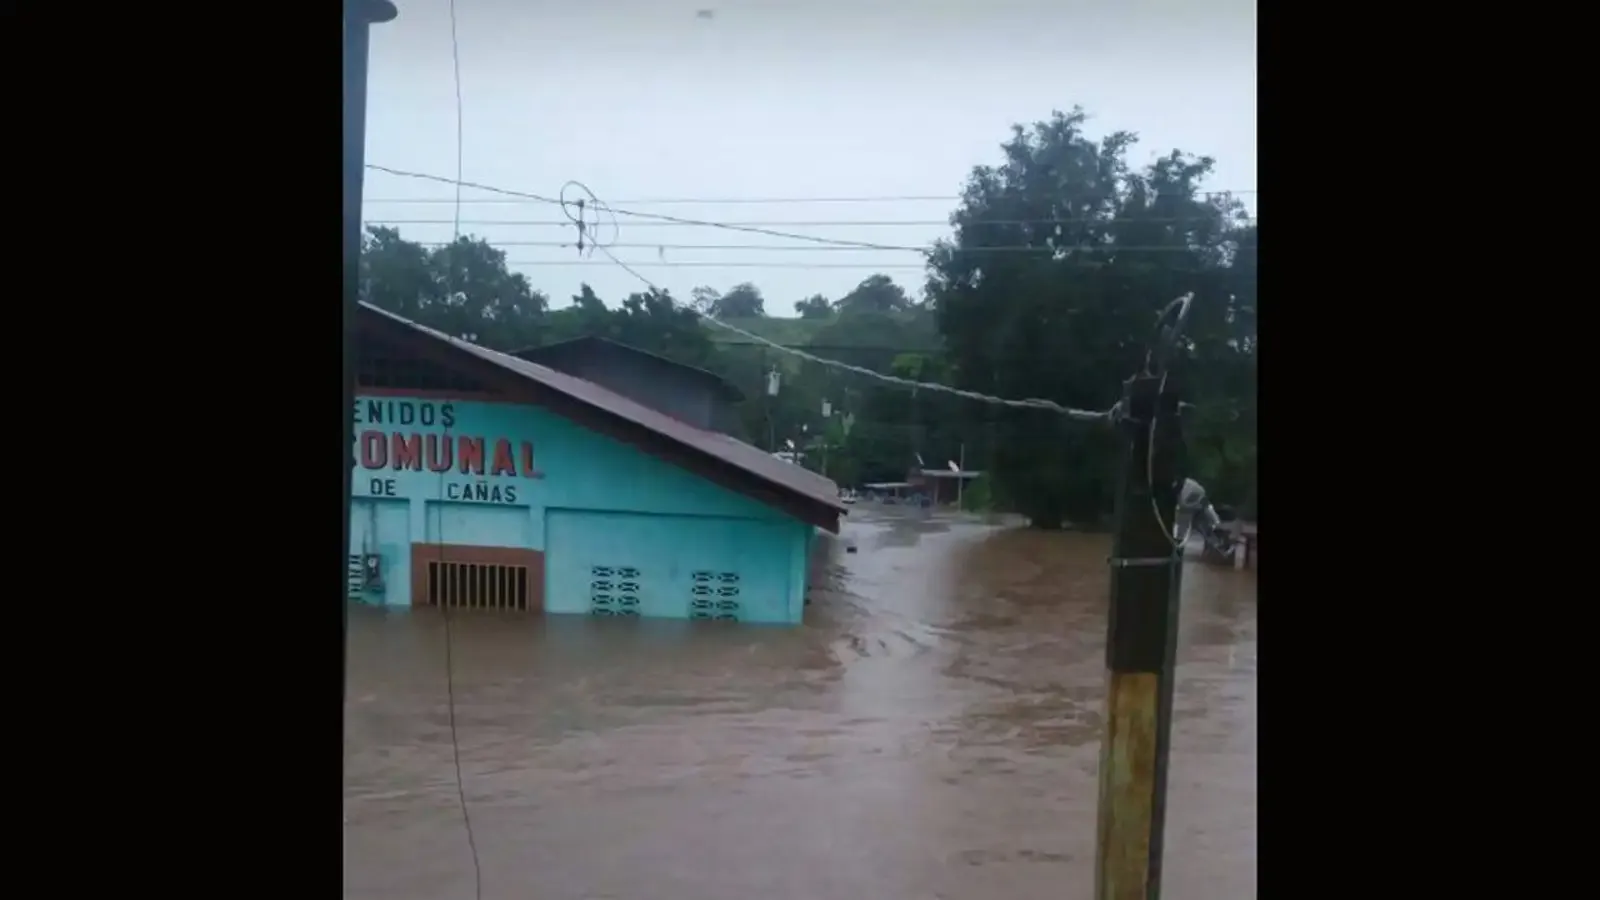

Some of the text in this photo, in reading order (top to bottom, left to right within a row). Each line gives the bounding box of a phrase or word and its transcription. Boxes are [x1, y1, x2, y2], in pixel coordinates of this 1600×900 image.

[351, 429, 545, 479] OMUNAL
[370, 478, 516, 502] DE CAÑAS
